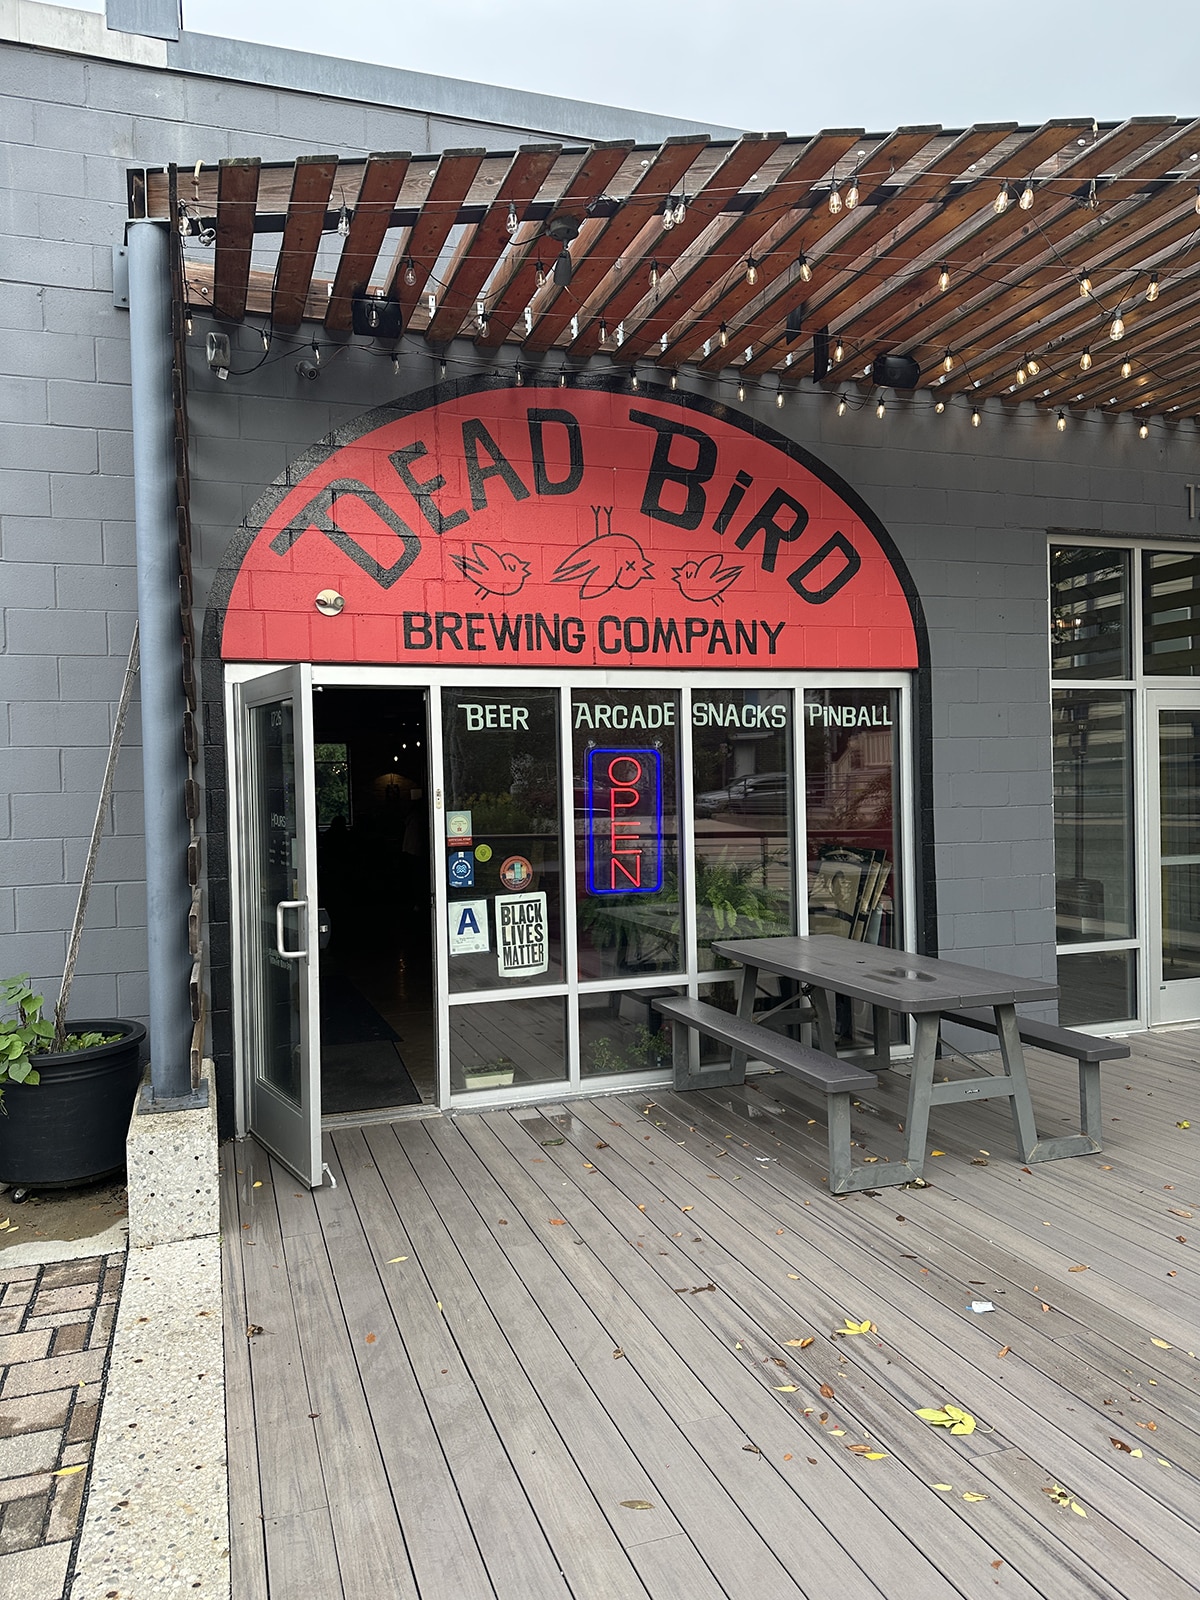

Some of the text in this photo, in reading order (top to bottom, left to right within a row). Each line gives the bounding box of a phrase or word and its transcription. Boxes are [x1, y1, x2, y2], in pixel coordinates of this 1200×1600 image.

[269, 408, 584, 590] DEAD
[599, 615, 786, 655] COMPANY
[457, 703, 529, 731] BEER
[572, 702, 675, 729] ARCADE
[692, 702, 786, 728] SNACKS
[607, 756, 643, 890] OPEN
[457, 907, 481, 935] A
[500, 903, 543, 926] BLACK
[501, 923, 544, 947] LIVES
[502, 943, 545, 967] MATTER
